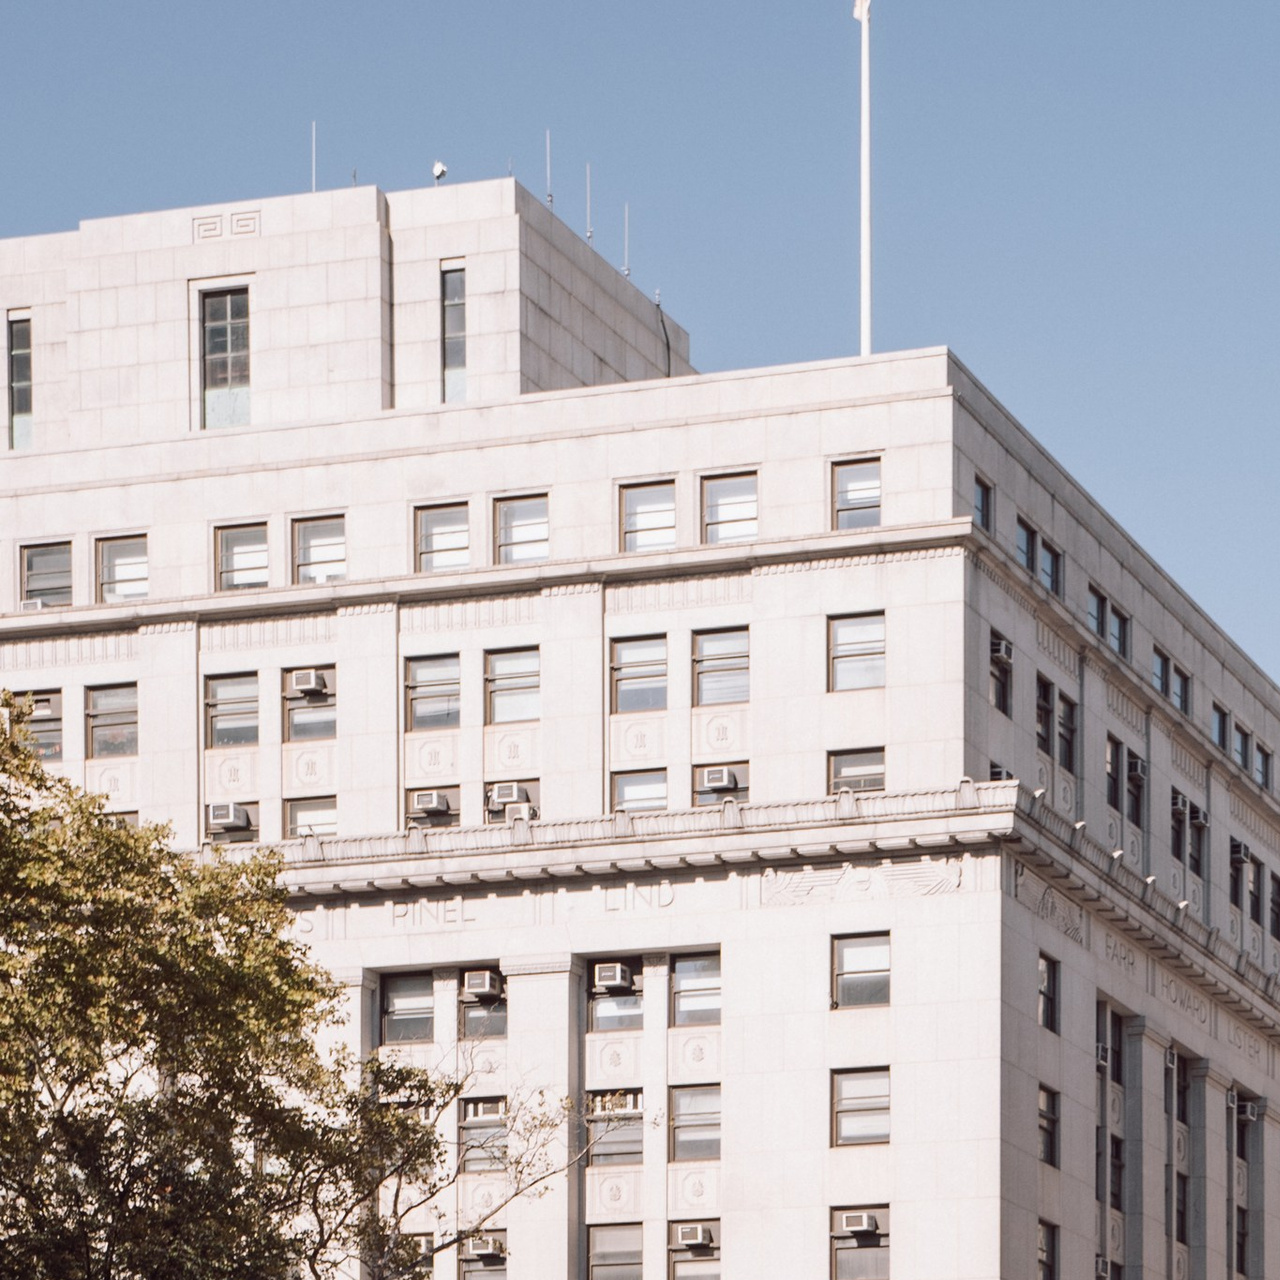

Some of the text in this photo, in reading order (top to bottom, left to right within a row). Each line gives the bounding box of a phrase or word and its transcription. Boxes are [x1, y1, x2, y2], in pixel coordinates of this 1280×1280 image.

[392, 881, 676, 927] PINEL LIND
[1161, 970, 1207, 1024] HOWARD
[1227, 1018, 1260, 1062] LISTER
